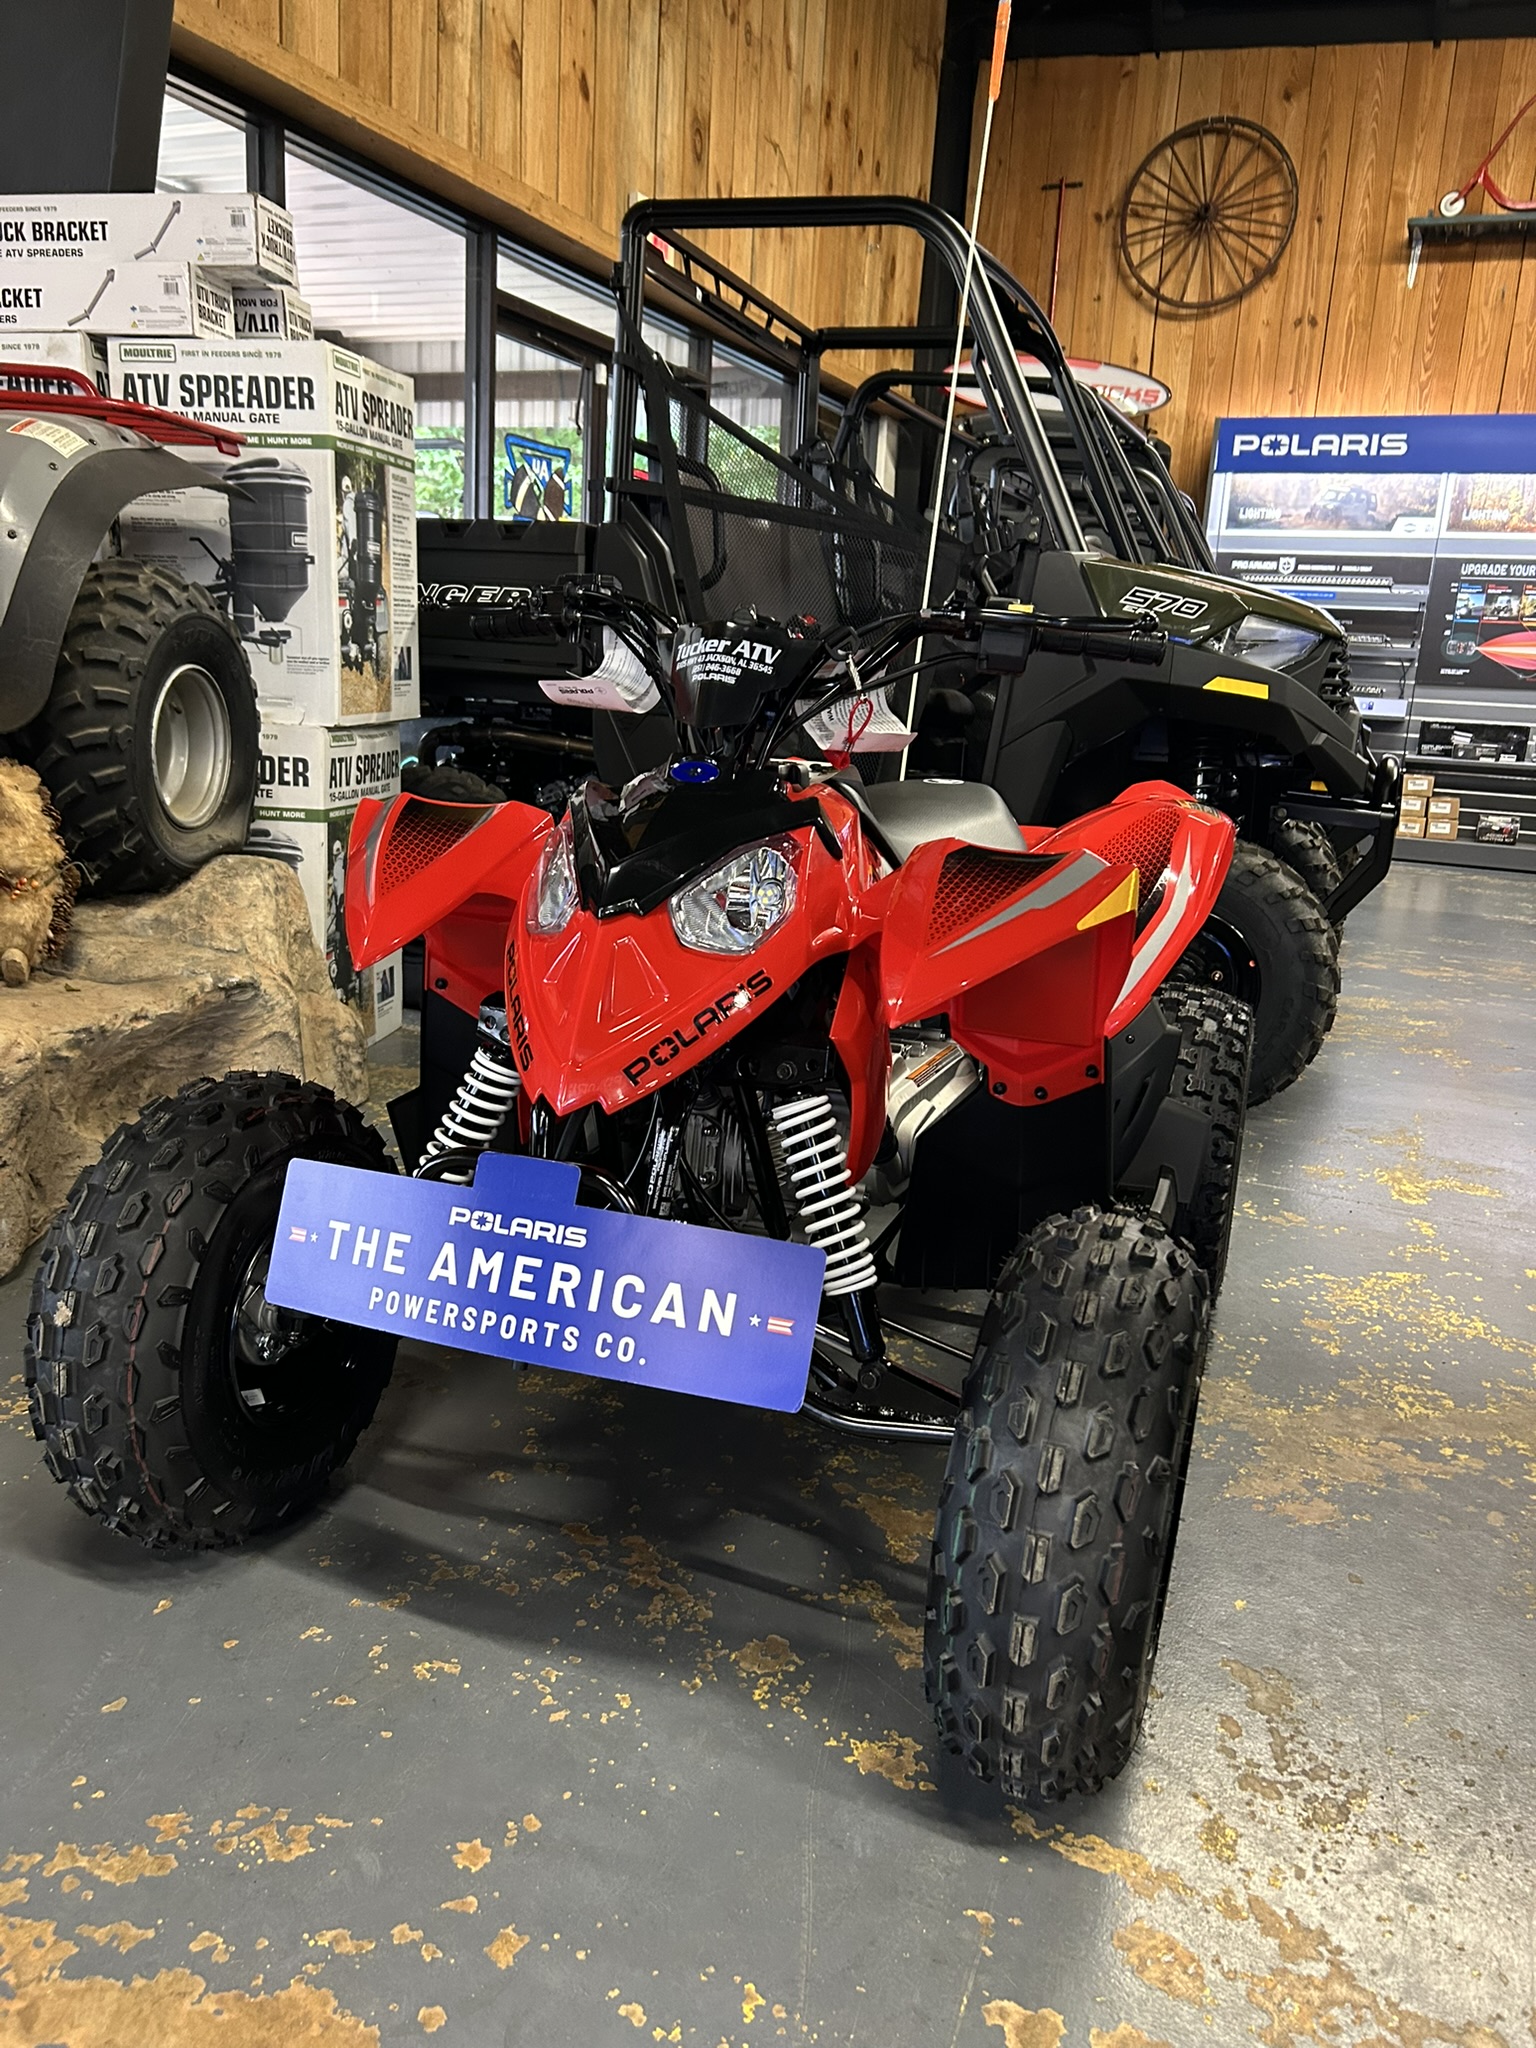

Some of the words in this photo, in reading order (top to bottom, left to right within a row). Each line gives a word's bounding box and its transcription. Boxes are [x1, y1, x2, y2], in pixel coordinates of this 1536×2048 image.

[32, 221, 109, 242] BRACKET
[5, 249, 24, 258] ATV
[27, 248, 84, 258] SPREADERS
[0, 288, 43, 308] CKET
[259, 298, 278, 308] FOR
[123, 348, 173, 358] MOULTRIE
[202, 350, 210, 358] IN
[211, 350, 241, 358] FEEDERS
[123, 373, 170, 407] ATV
[179, 374, 316, 410] SPREADER
[194, 411, 246, 423] MANUAL
[249, 413, 280, 424] GATE
[335, 380, 358, 421] ATV
[362, 391, 414, 440] SPREADER
[267, 437, 288, 445] HUNT
[290, 438, 312, 446] MORE
[1233, 433, 1409, 457] POLARIS
[530, 458, 550, 481] UA
[1238, 506, 1282, 520] LIGHTING
[1462, 508, 1510, 521] LIGHTING
[1460, 563, 1509, 577] UPGRADE
[1509, 564, 1536, 577] YOUR
[1119, 585, 1209, 620] 570
[676, 636, 732, 662] Tucker
[731, 639, 782, 665] ATV
[705, 652, 737, 667] JACKSON,
[737, 658, 748, 668] AL
[748, 661, 774, 675] 36545
[691, 672, 737, 685] POLARIS
[262, 733, 278, 741] 1979
[329, 757, 352, 789] ATV
[355, 750, 400, 786] SPREADER
[329, 789, 360, 802] 15-GALLON
[380, 783, 392, 794] GATE
[259, 810, 281, 818] HUNT
[283, 811, 306, 819] MORE
[506, 939, 535, 1073] POLARIS
[622, 967, 774, 1087] POLARIS
[448, 1206, 588, 1249] POLARIS
[327, 1219, 412, 1276] THE
[428, 1241, 738, 1338] AMERICAN
[368, 1286, 581, 1354] POWERSPORTS
[595, 1330, 648, 1367] CO.
